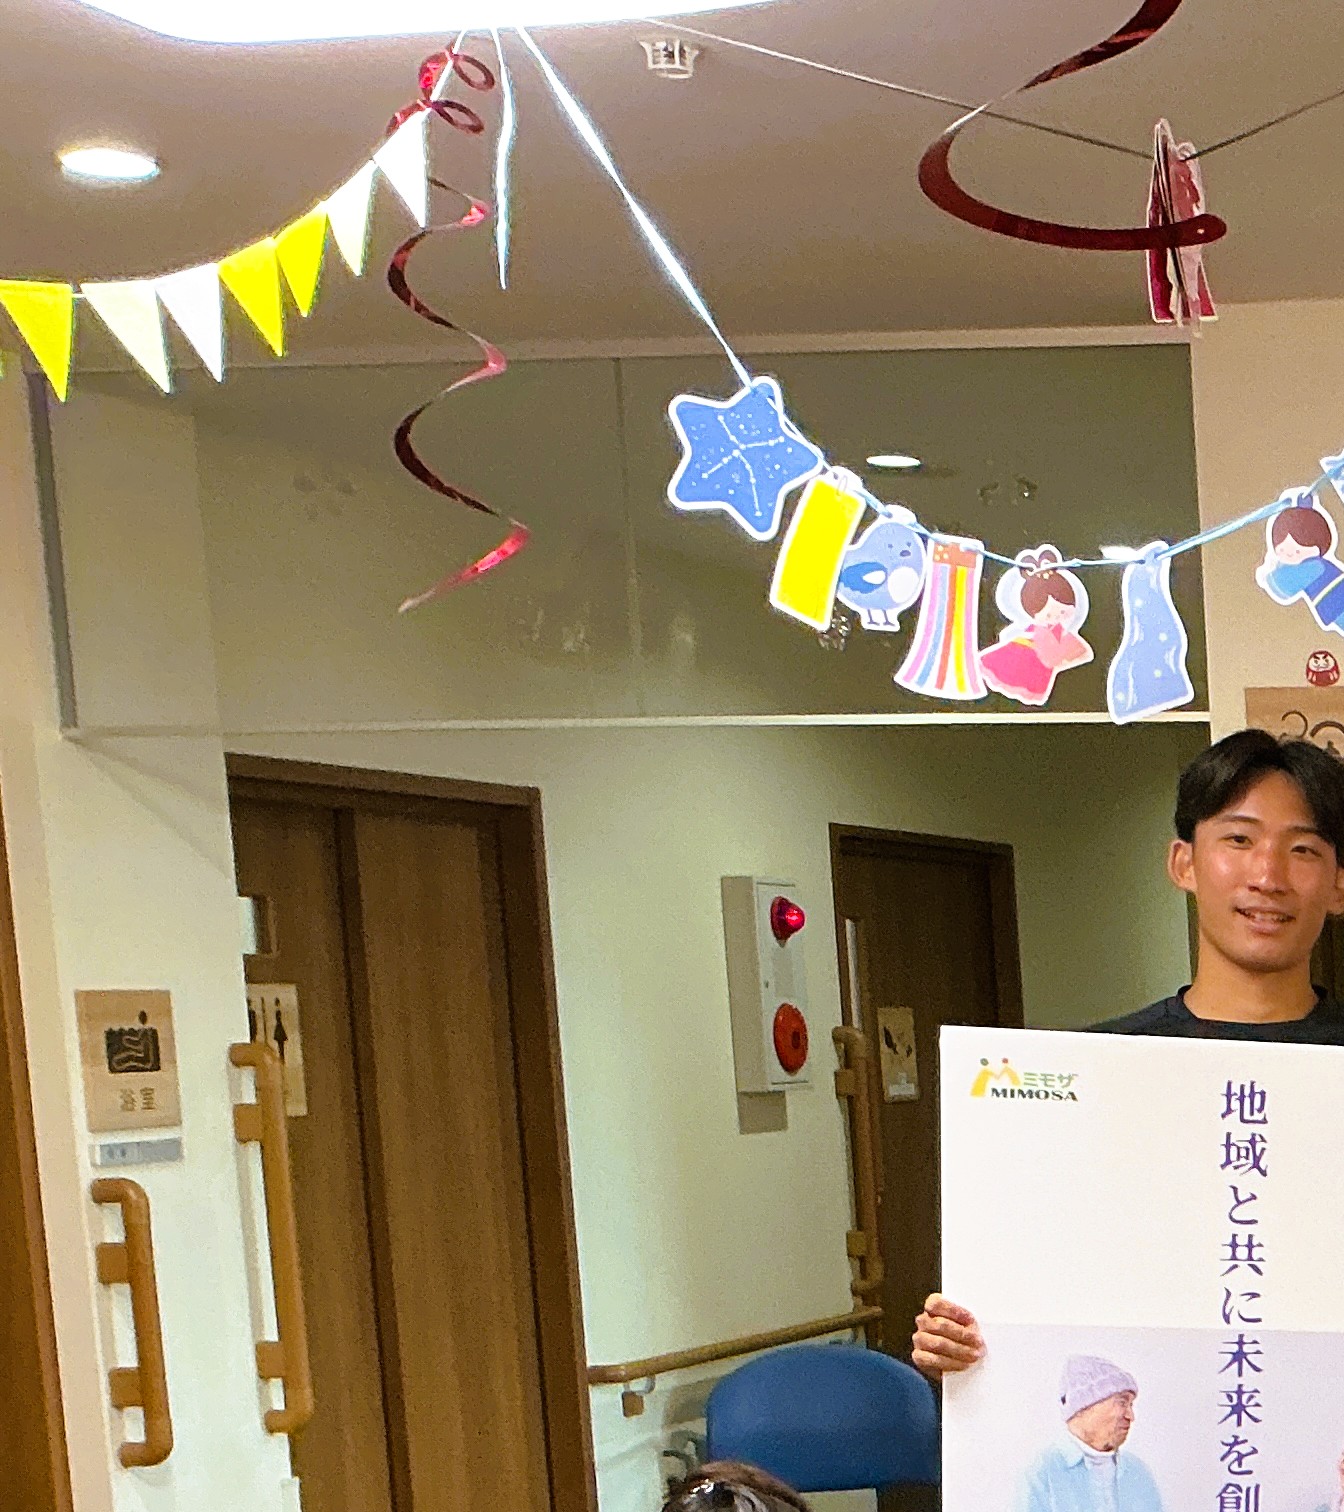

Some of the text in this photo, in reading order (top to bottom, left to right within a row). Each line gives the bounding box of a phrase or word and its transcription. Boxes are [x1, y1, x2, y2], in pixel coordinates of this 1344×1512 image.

[1023, 1072, 1079, 1088] ミモザ
[991, 1088, 1078, 1101] MIMOSA
